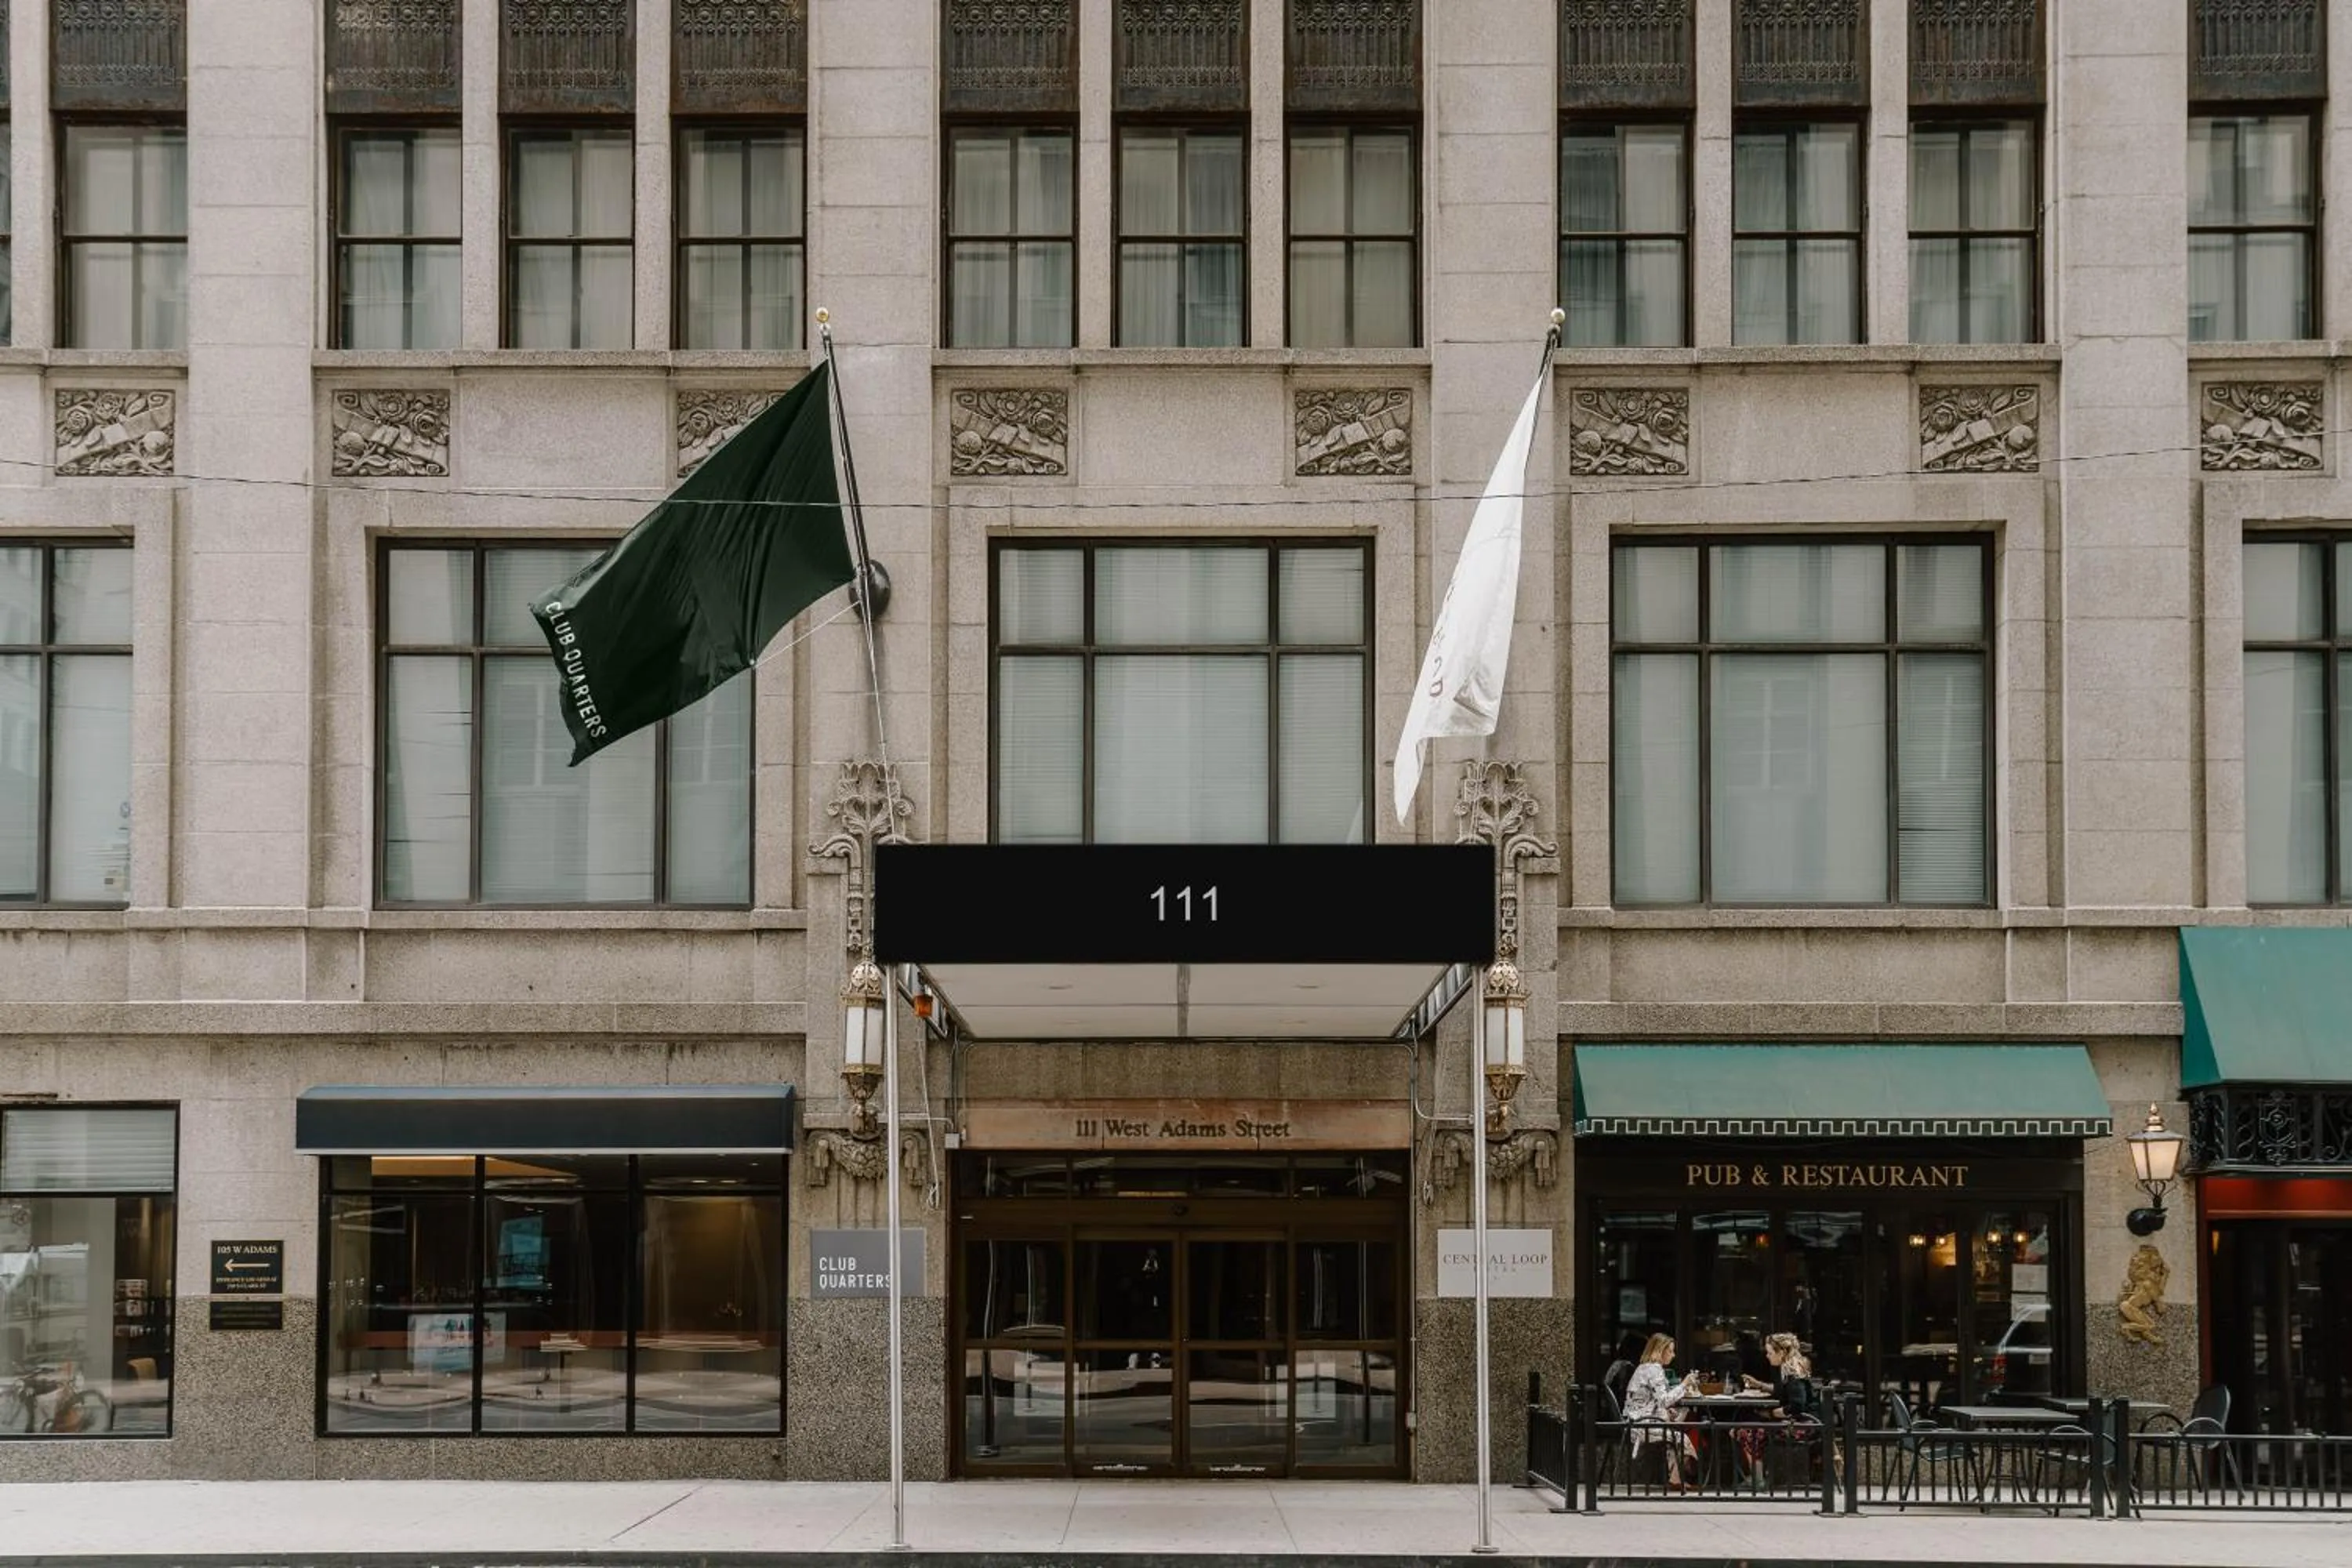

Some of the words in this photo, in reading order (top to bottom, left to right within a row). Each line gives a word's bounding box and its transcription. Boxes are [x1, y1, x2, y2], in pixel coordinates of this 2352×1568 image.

[546, 601, 575, 645] CLUB
[562, 648, 608, 738] QUARTERS
[1150, 885, 1217, 921] 111
[1076, 1120, 1097, 1137] 111
[1104, 1120, 1150, 1137] West
[1160, 1120, 1226, 1138] Adams
[1235, 1120, 1290, 1138] Street
[1686, 1164, 1741, 1186] PUB
[1751, 1164, 1770, 1186] &
[1781, 1164, 1969, 1186] RESTAURANT
[233, 1245, 242, 1254] W
[243, 1245, 278, 1254] ADAMS
[818, 1256, 857, 1271] CLUB
[1443, 1254, 1506, 1265] CENTAL
[1512, 1254, 1548, 1265] LOOP
[818, 1273, 891, 1290] QUARTERS
